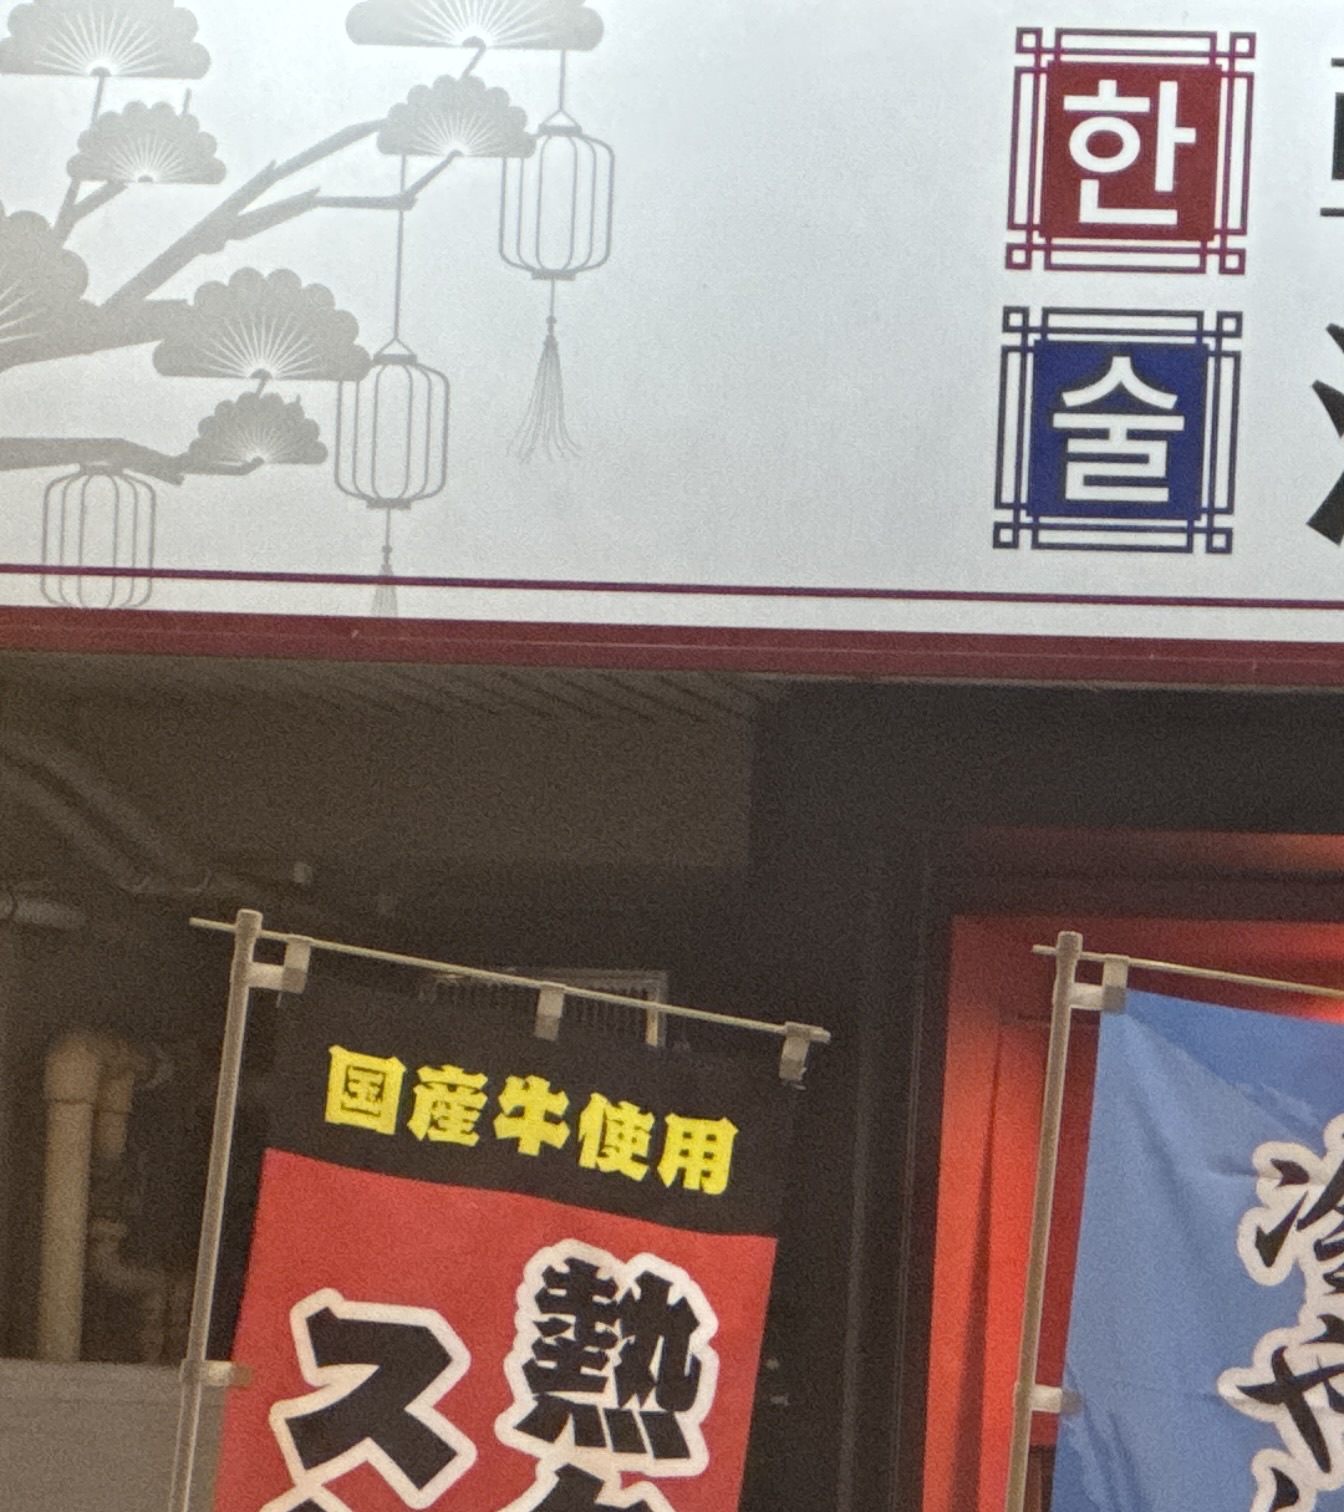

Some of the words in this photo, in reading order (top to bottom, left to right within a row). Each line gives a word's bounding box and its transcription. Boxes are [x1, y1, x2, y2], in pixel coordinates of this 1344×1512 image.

[1062, 78, 1196, 228] 한
[1050, 354, 1186, 507] 술
[323, 1045, 739, 1196] 国産牛使用
